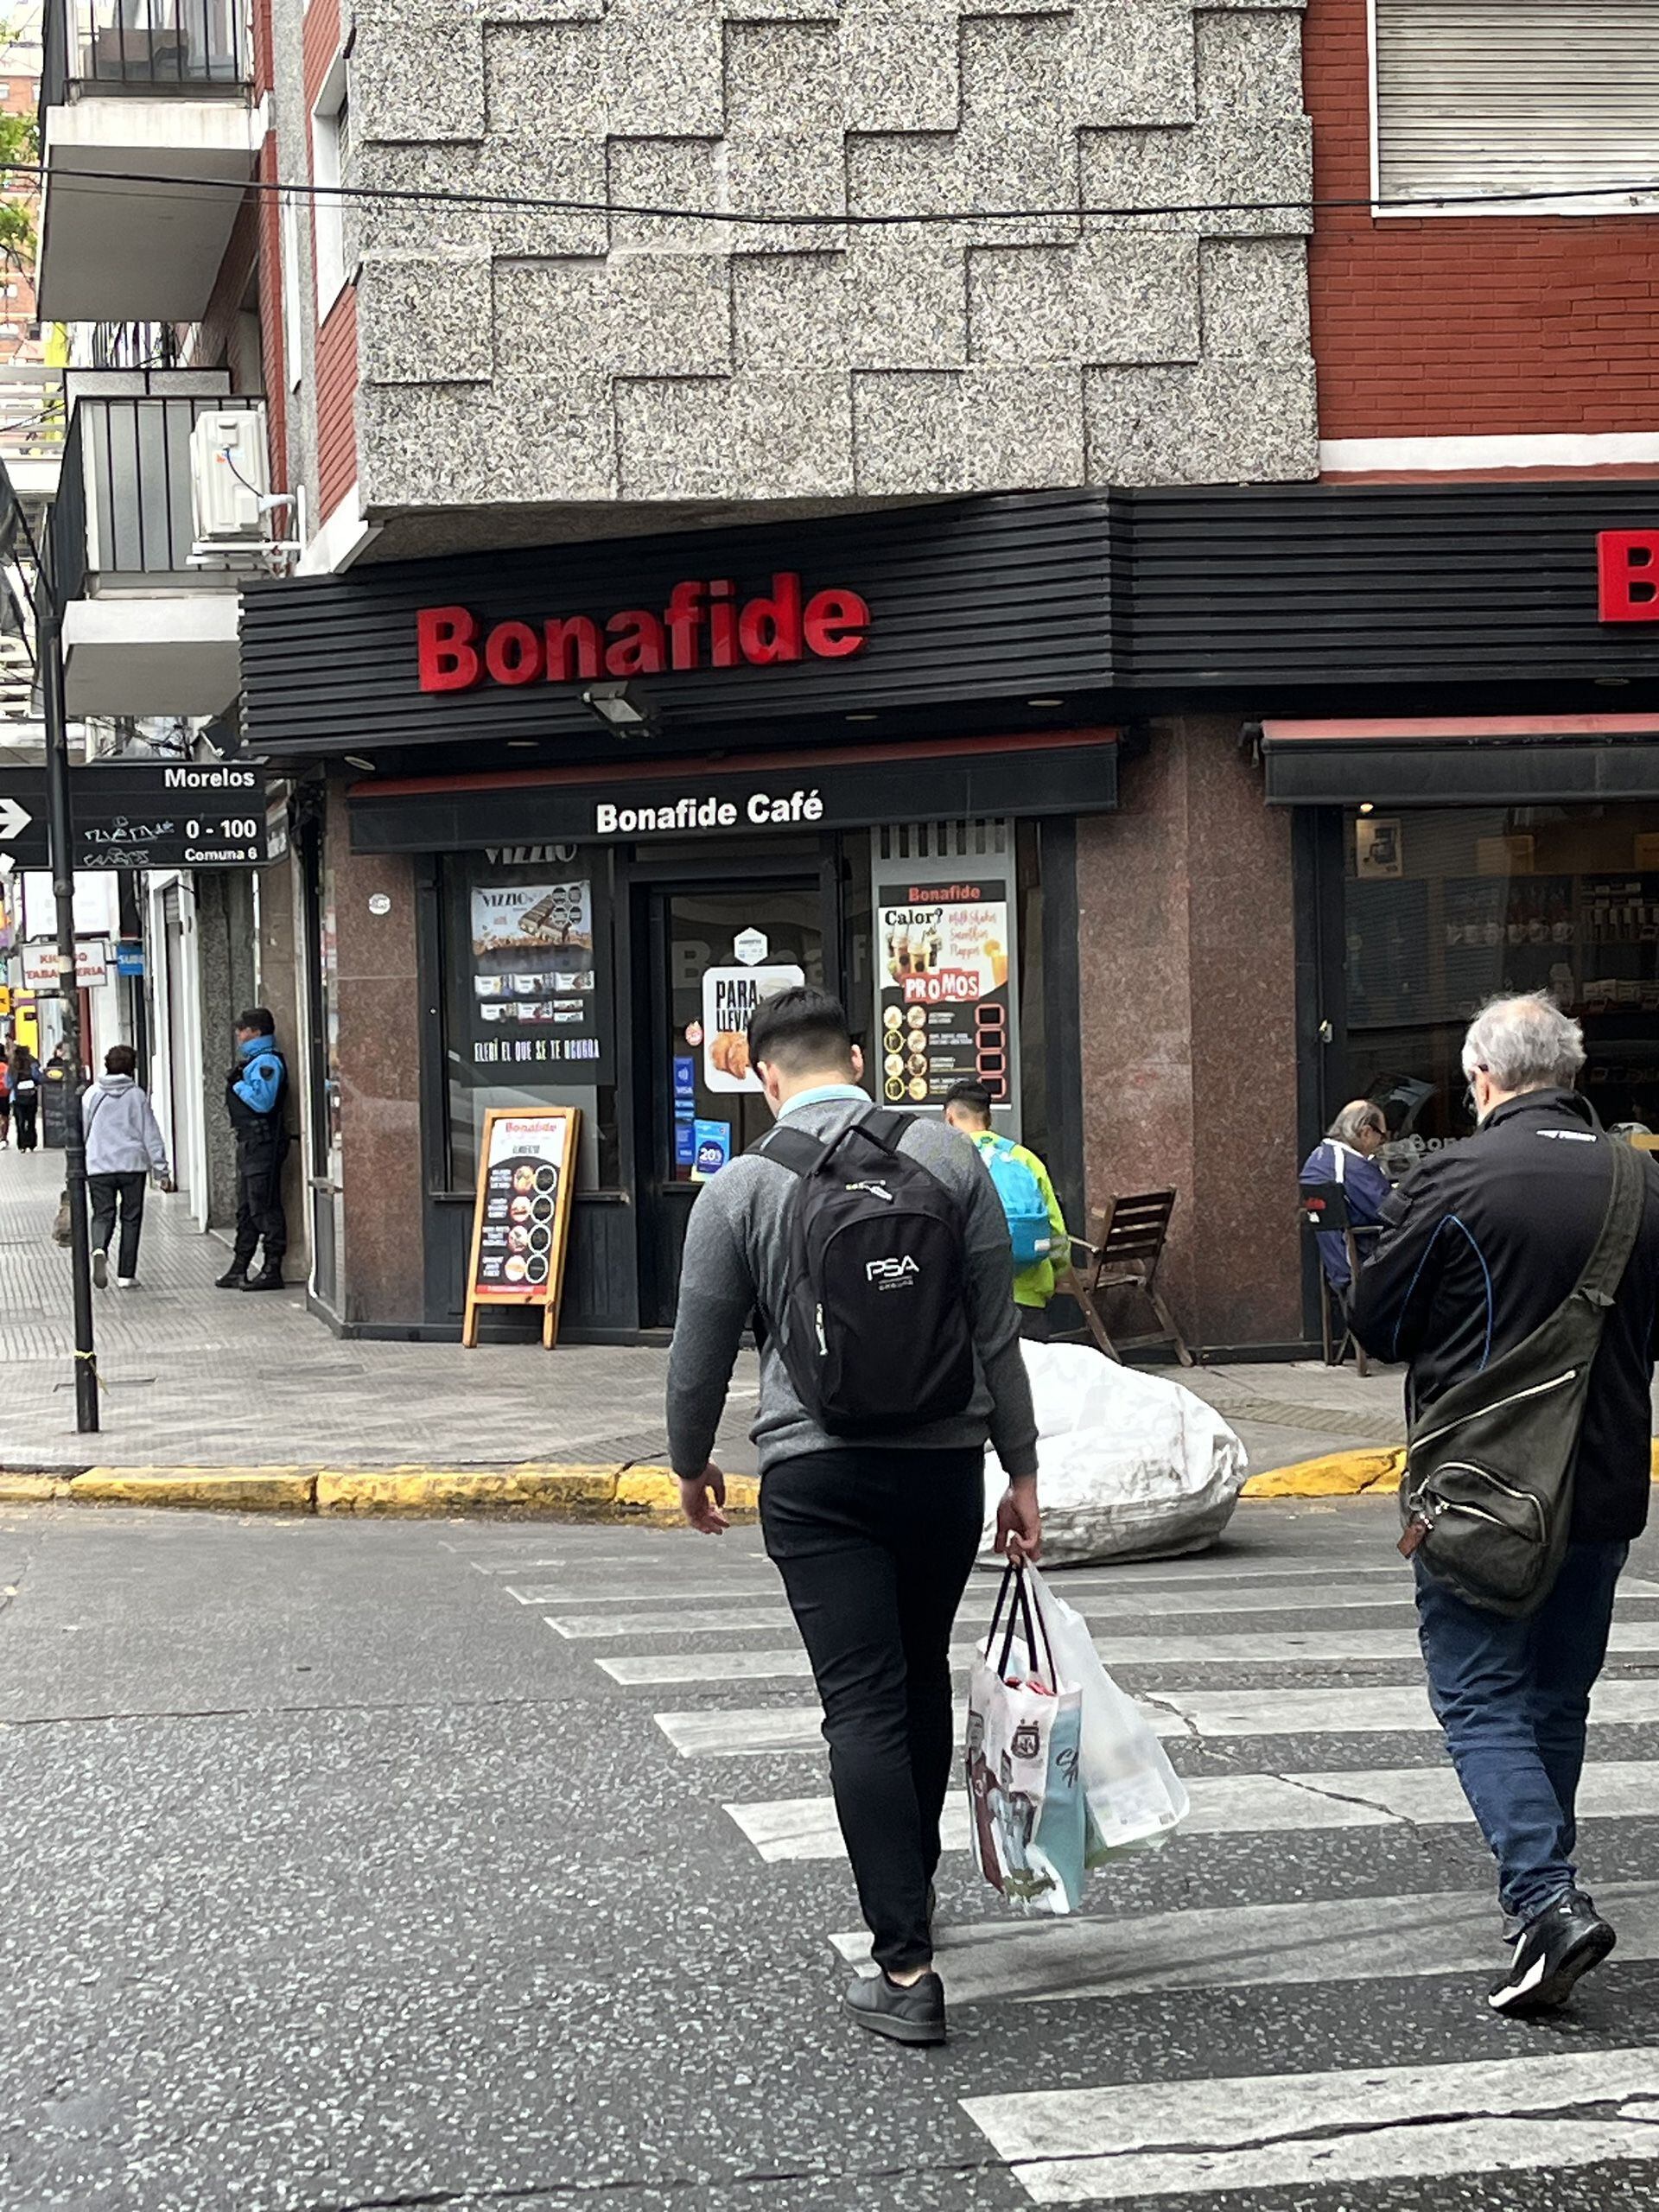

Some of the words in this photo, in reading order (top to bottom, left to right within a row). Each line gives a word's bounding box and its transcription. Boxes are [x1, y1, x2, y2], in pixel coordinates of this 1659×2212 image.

[416, 571, 871, 693] Bonafide
[164, 767, 256, 788] Morelos
[596, 797, 738, 833] Bonafide
[747, 789, 823, 823] Café
[186, 819, 200, 839] 0
[219, 819, 257, 838] 100
[184, 848, 245, 861] Comuna
[247, 847, 258, 860] 6
[482, 893, 526, 907] VIZZIO
[908, 885, 982, 902] Bonafide
[885, 907, 944, 925] Calor?
[24, 966, 105, 980] TABAERIA
[716, 980, 759, 1009] PARA
[905, 972, 979, 1000] PROMOS
[716, 1009, 752, 1033] LLEVA
[866, 1255, 920, 1281] PSA
